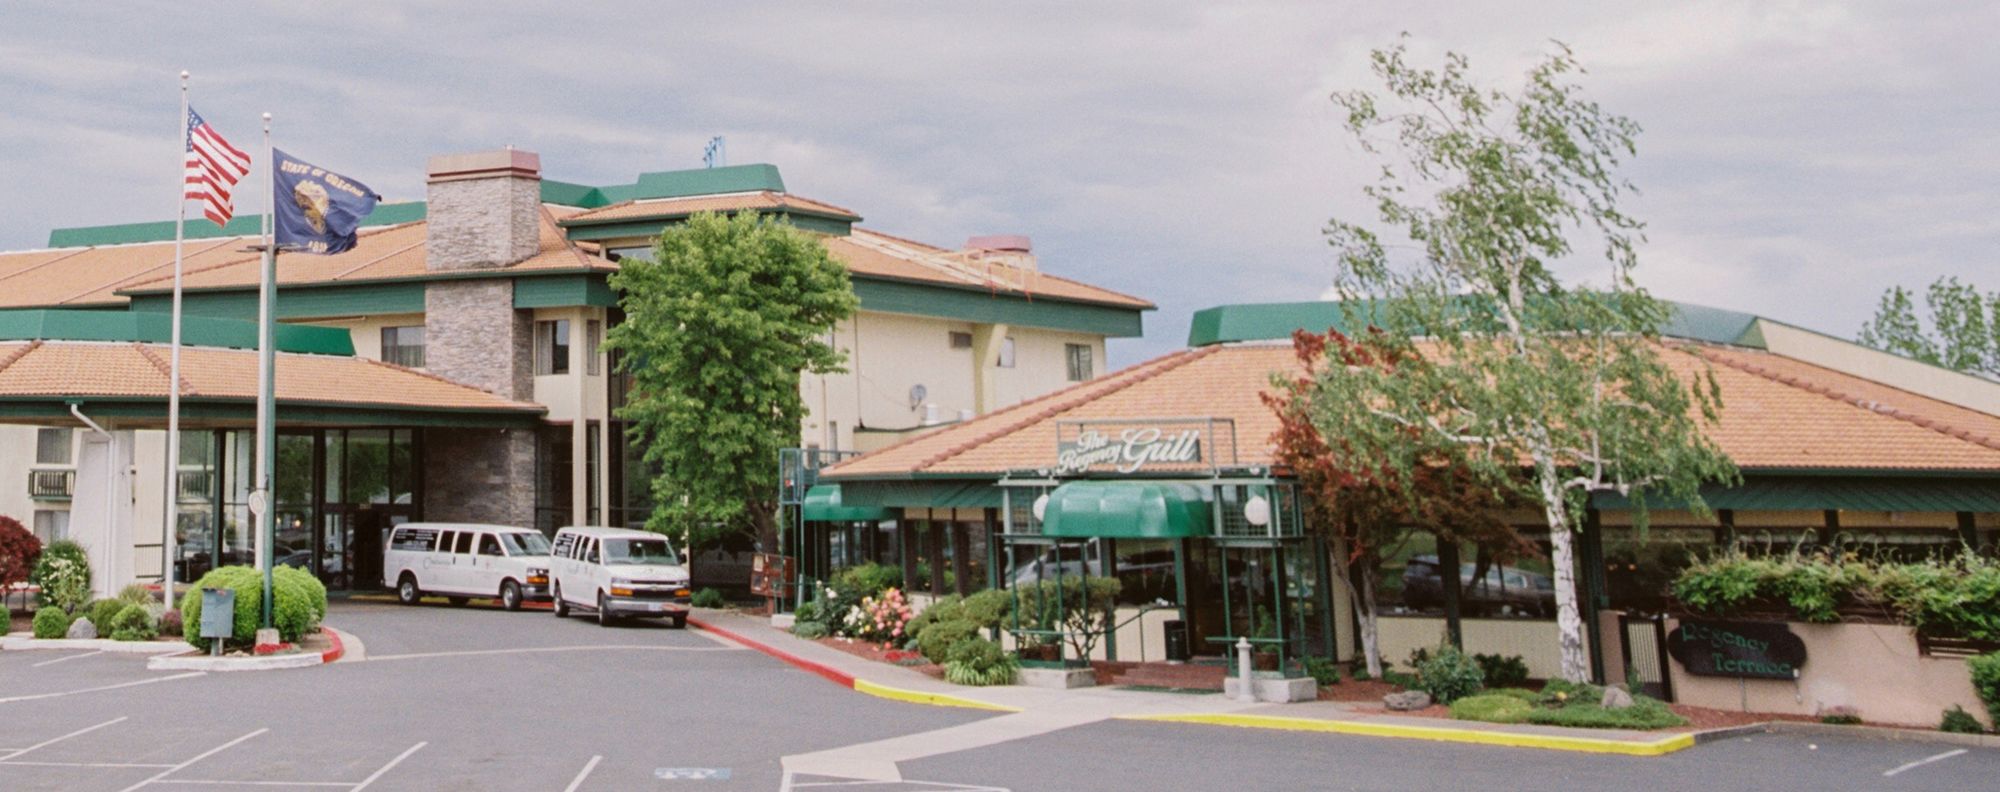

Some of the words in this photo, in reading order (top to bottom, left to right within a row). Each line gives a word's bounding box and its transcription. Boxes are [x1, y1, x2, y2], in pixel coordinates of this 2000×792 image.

[281, 160, 310, 174] STATE
[311, 168, 326, 177] OF
[325, 173, 364, 197] OREGON
[1076, 429, 1109, 453] The
[1117, 428, 1200, 474] Grill
[1056, 445, 1121, 474] Regency
[1681, 623, 1770, 652] Regency
[1712, 652, 1792, 674] Terrace
